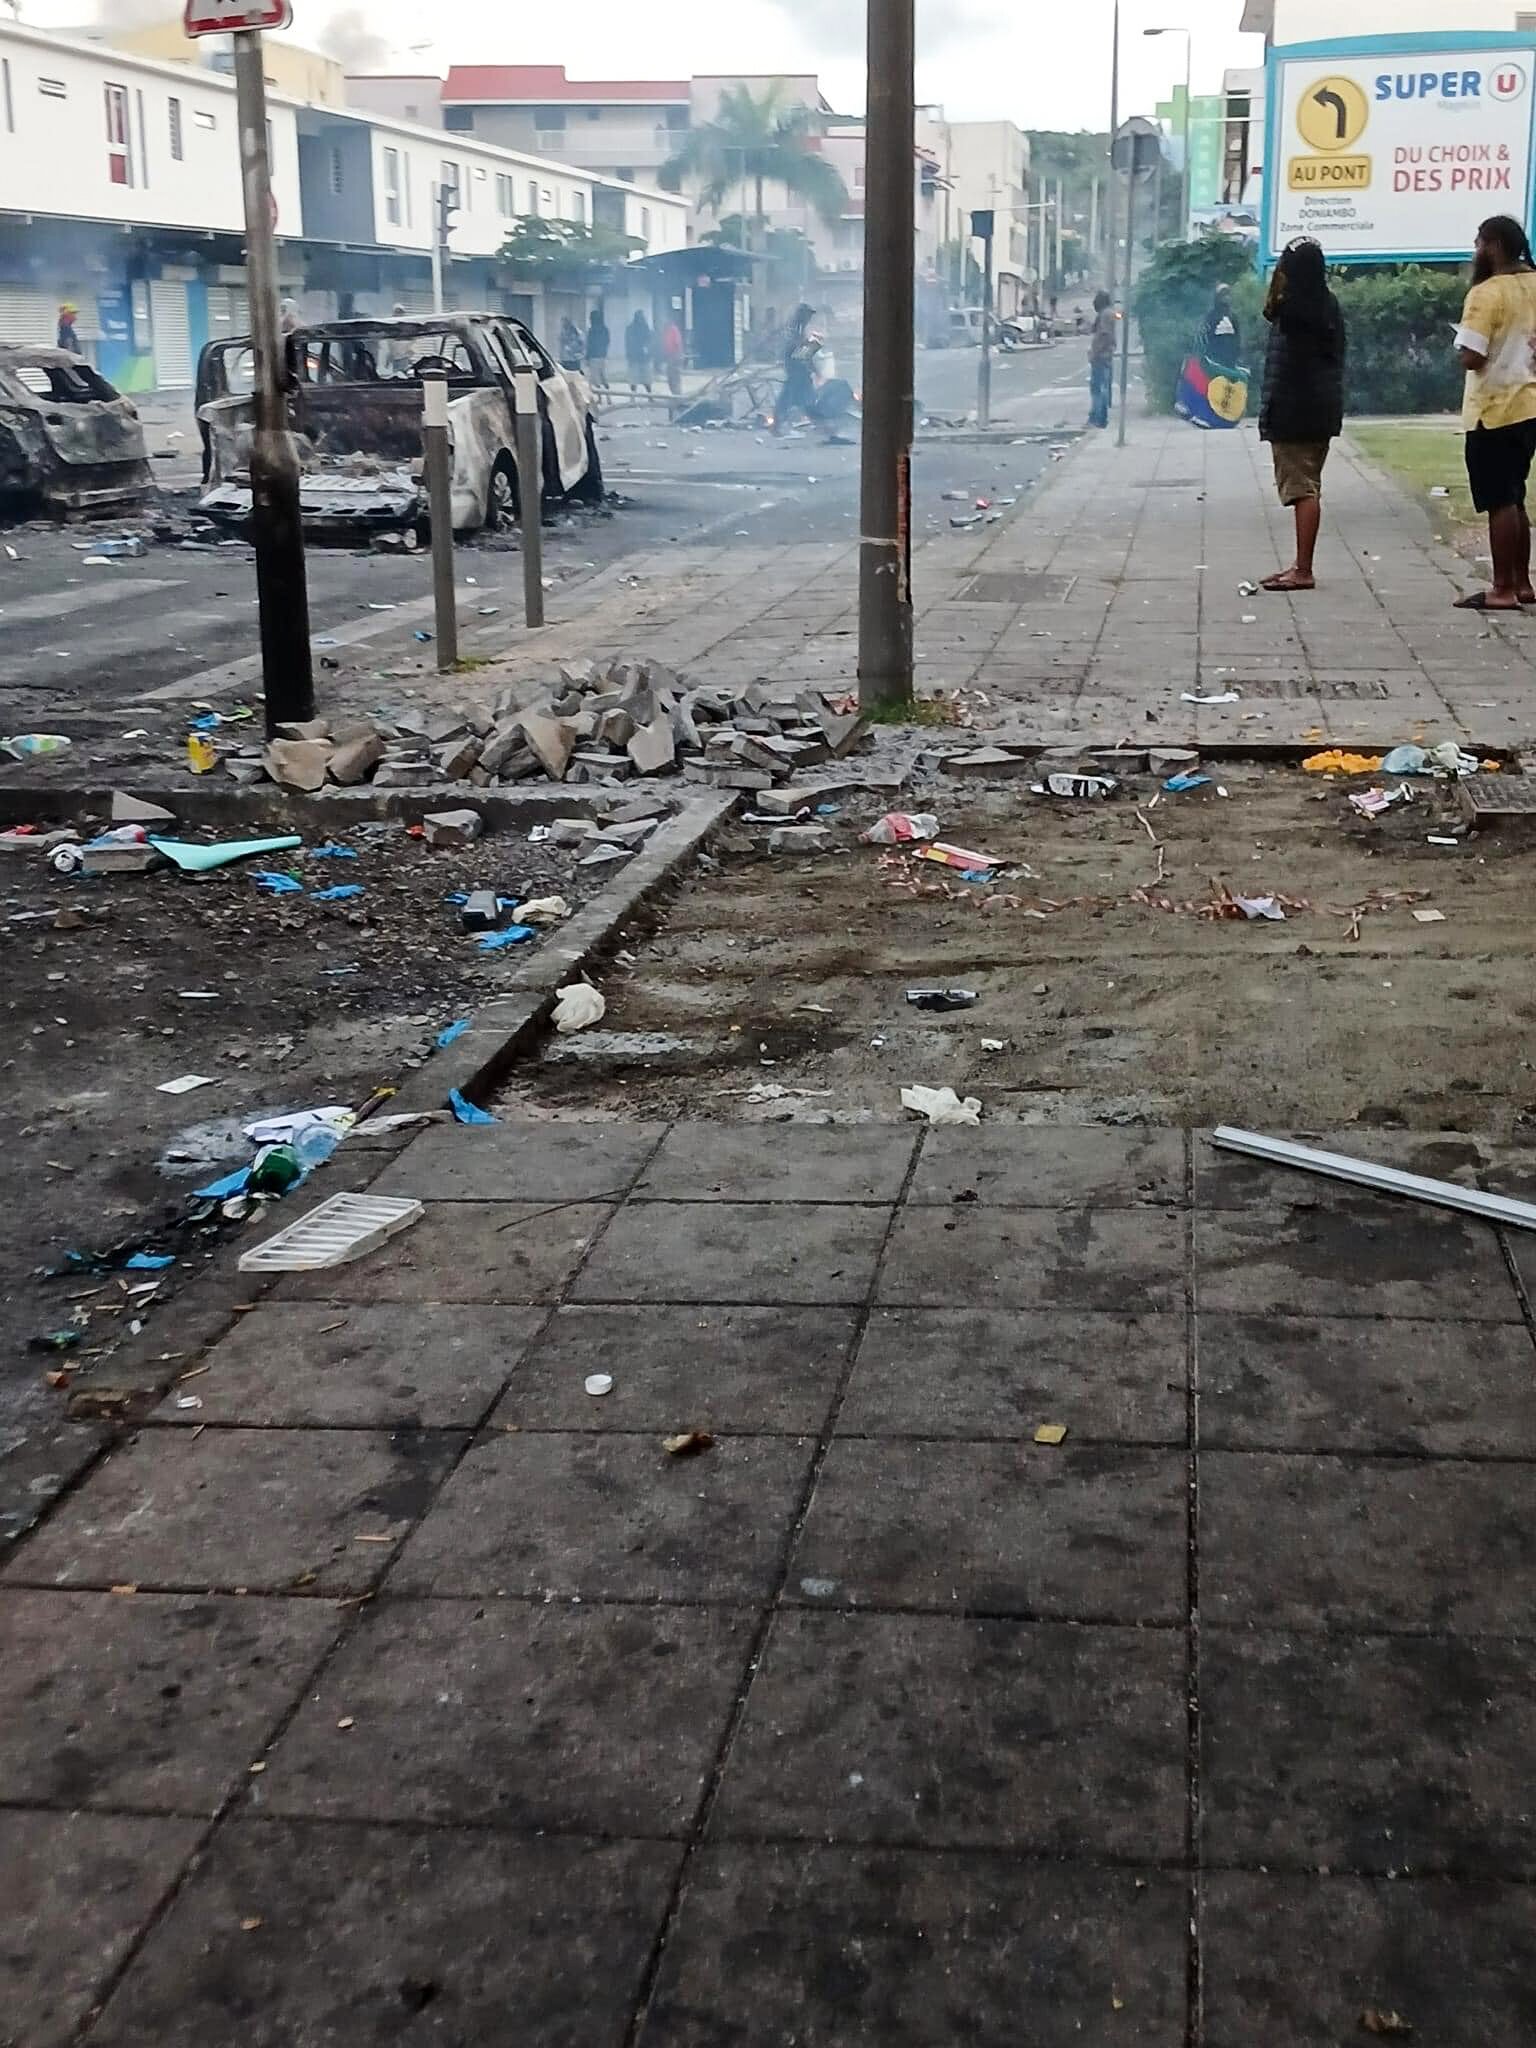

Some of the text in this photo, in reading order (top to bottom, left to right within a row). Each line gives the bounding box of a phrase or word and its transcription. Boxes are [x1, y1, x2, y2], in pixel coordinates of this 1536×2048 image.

[1375, 70, 1517, 101] SUPER U
[1394, 143, 1510, 164] DU CHOIX &
[1295, 164, 1367, 181] AU PONT
[1393, 166, 1511, 192] DES PRIX
[1280, 222, 1304, 232] Zone
